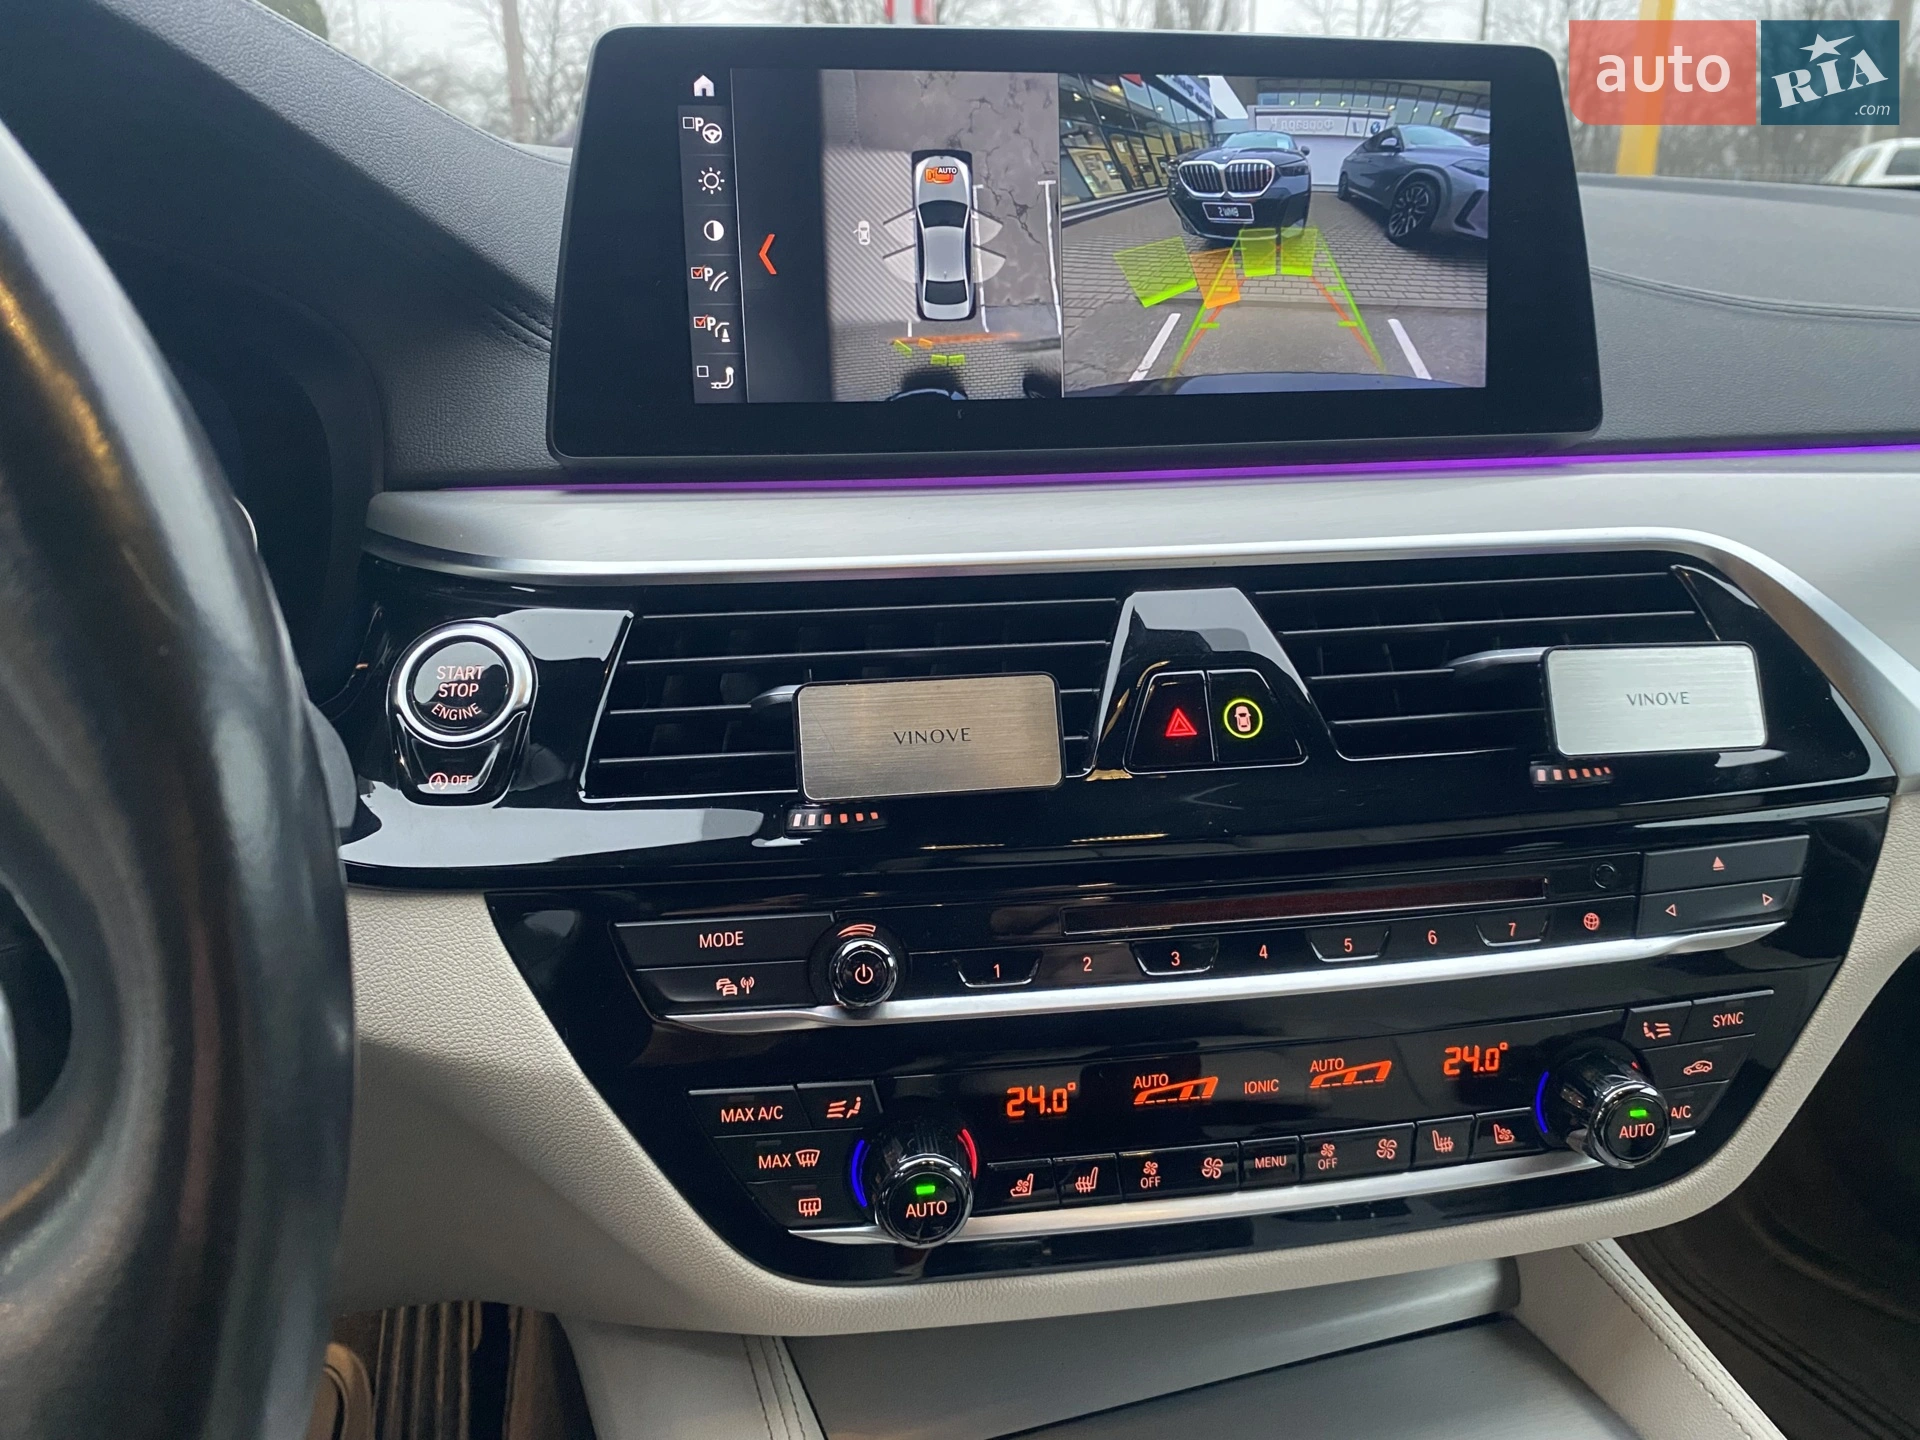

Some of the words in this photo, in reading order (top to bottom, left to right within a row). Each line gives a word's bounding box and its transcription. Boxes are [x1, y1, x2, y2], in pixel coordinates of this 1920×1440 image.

[436, 665, 485, 680] START
[438, 683, 479, 698] STOP
[1626, 691, 1690, 706] VINOVE
[430, 702, 482, 721] ENGINE
[893, 727, 972, 745] VINOVE
[451, 775, 473, 785] OFF
[699, 930, 744, 949] MODE
[993, 965, 1001, 978] 1
[1083, 957, 1092, 973] 2
[1171, 951, 1180, 967] 3
[1259, 945, 1268, 959] 4
[1344, 937, 1353, 952] 5
[1427, 929, 1437, 945] 6
[1508, 922, 1517, 937] 7
[1712, 1011, 1745, 1028] SYNC
[1310, 1058, 1344, 1072] AUTO
[1133, 1073, 1169, 1088] AUTO
[1244, 1079, 1279, 1094] IONIC
[720, 1108, 755, 1123] MAX
[758, 1105, 784, 1121] A/C
[1671, 1105, 1692, 1119] A/C
[1618, 1123, 1655, 1139] AUTO
[758, 1153, 791, 1169] MAX
[1254, 1155, 1287, 1169] MENU
[1317, 1157, 1338, 1170] OFF
[1140, 1176, 1161, 1189] OFF
[905, 1200, 948, 1218] AUTO
